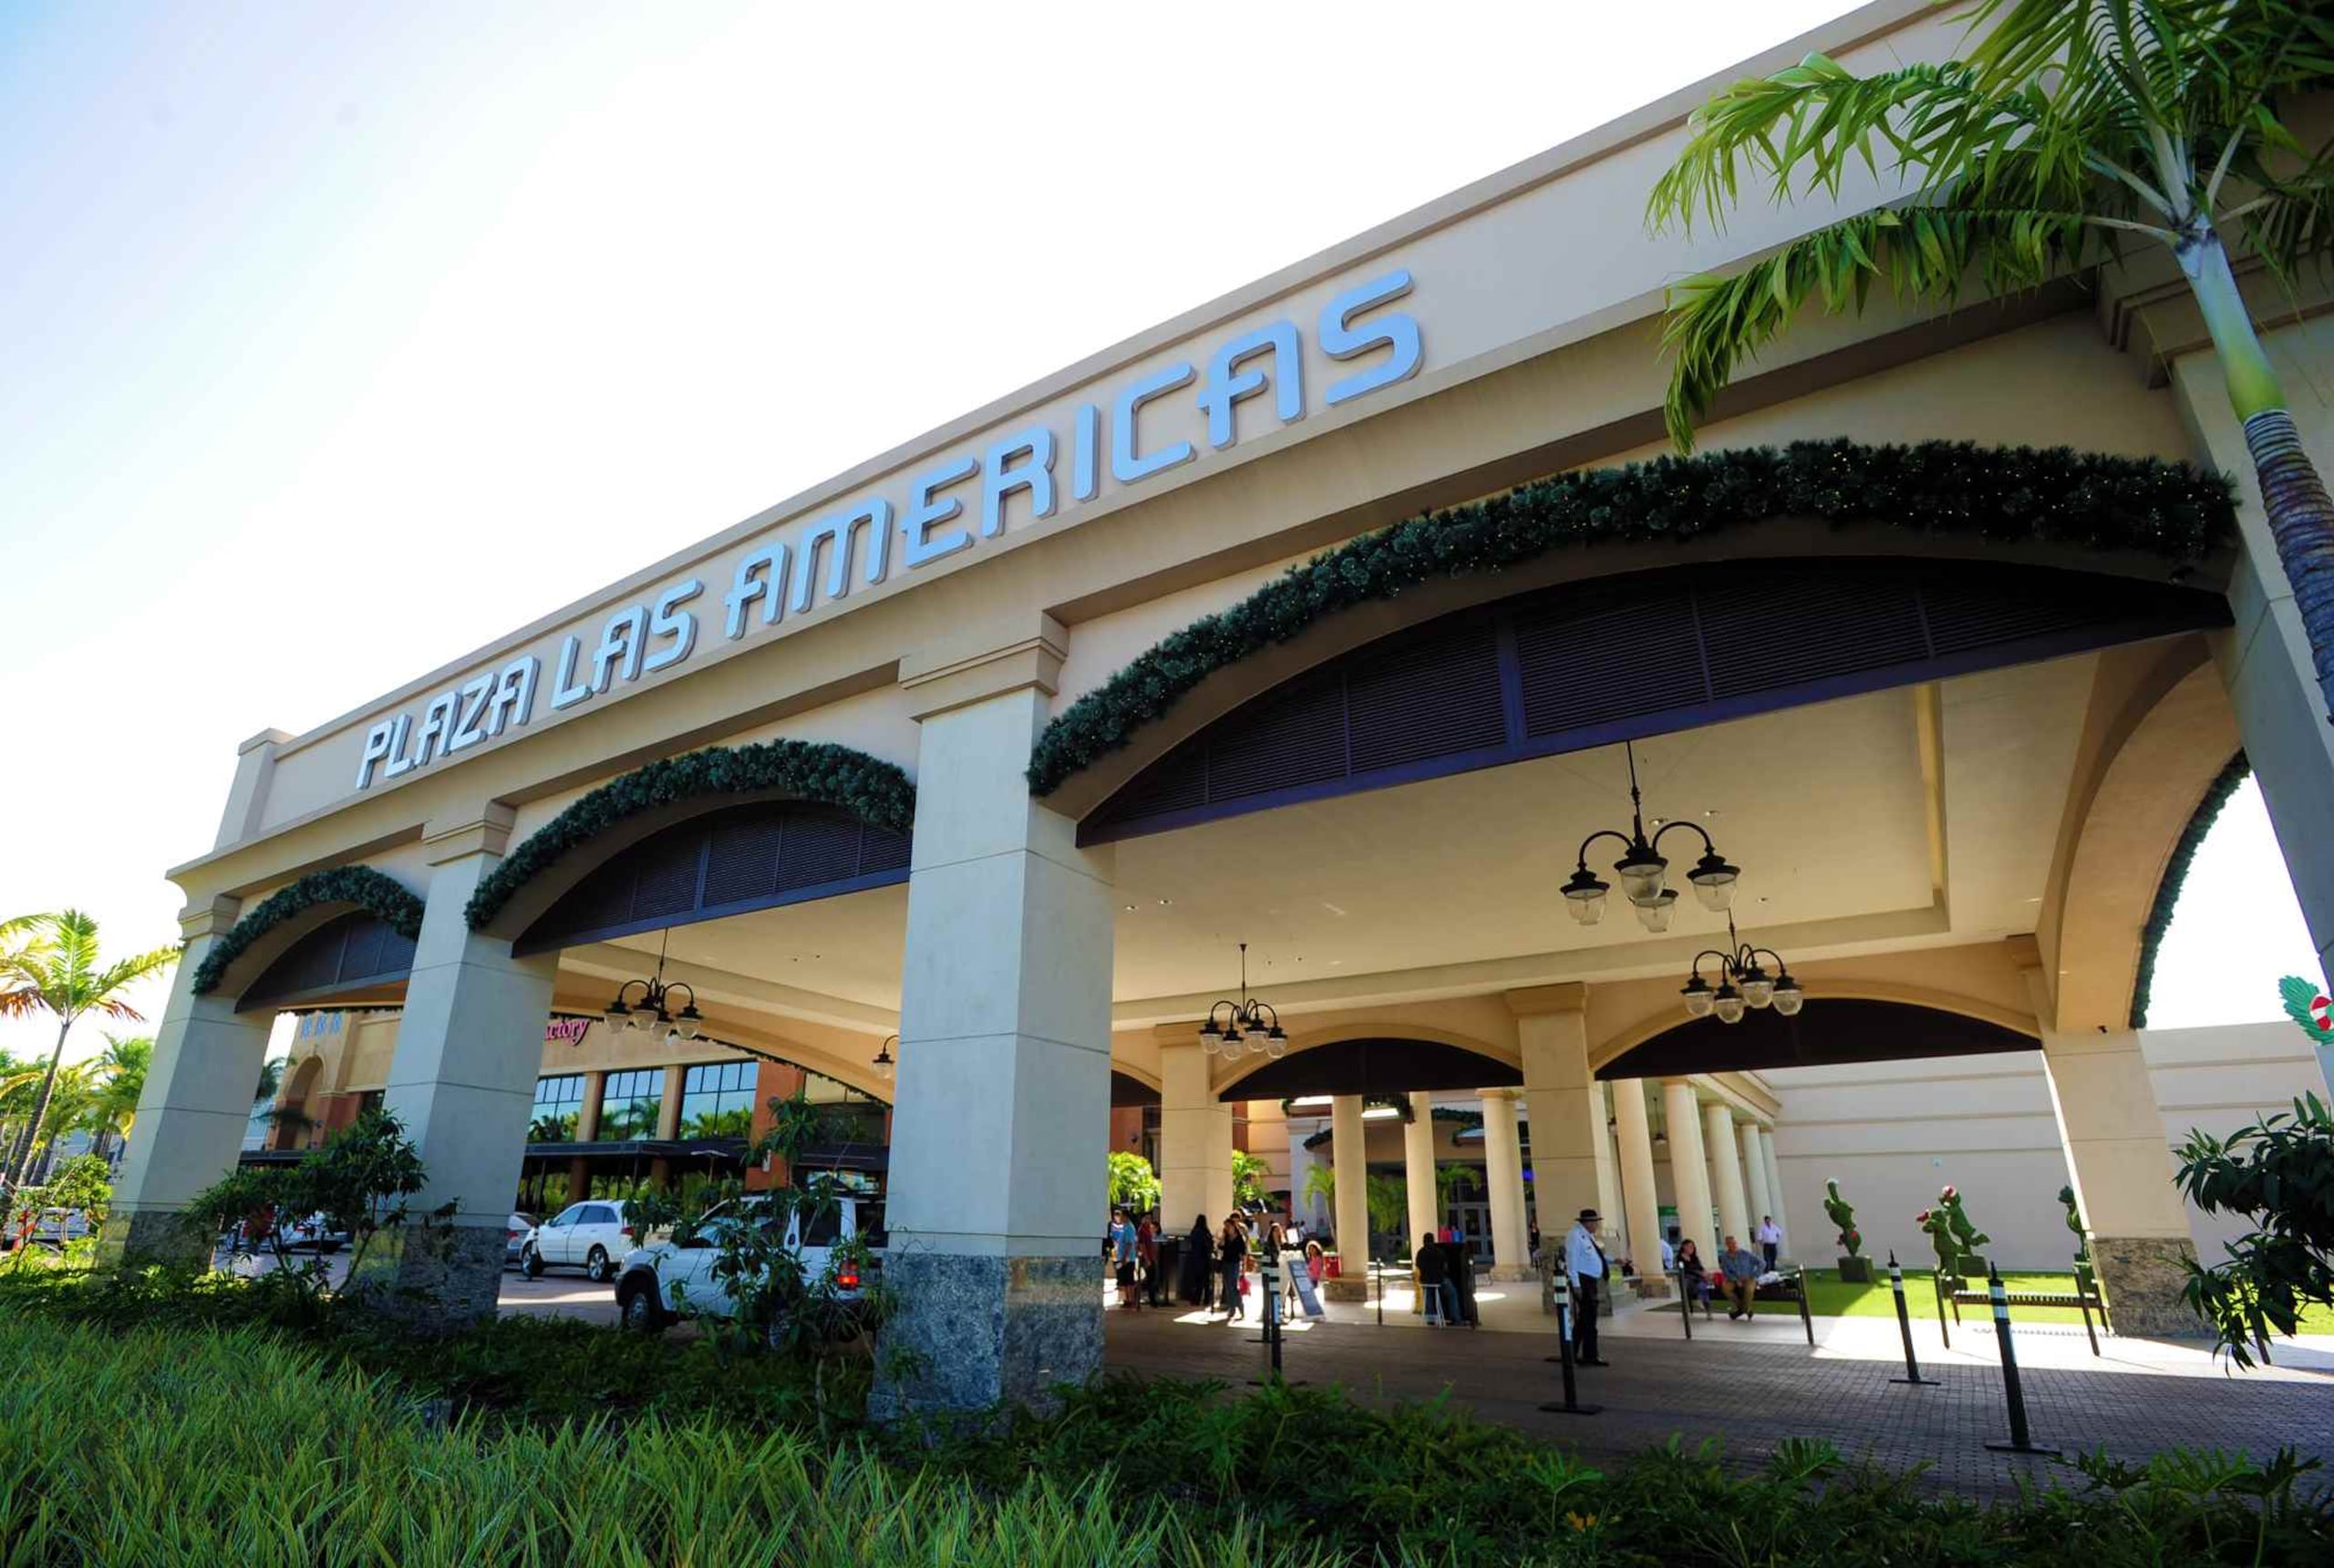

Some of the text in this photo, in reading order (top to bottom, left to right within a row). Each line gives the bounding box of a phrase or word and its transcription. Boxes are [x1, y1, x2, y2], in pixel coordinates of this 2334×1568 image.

[356, 269, 1423, 790] PLAZA LAS AMERICAS
